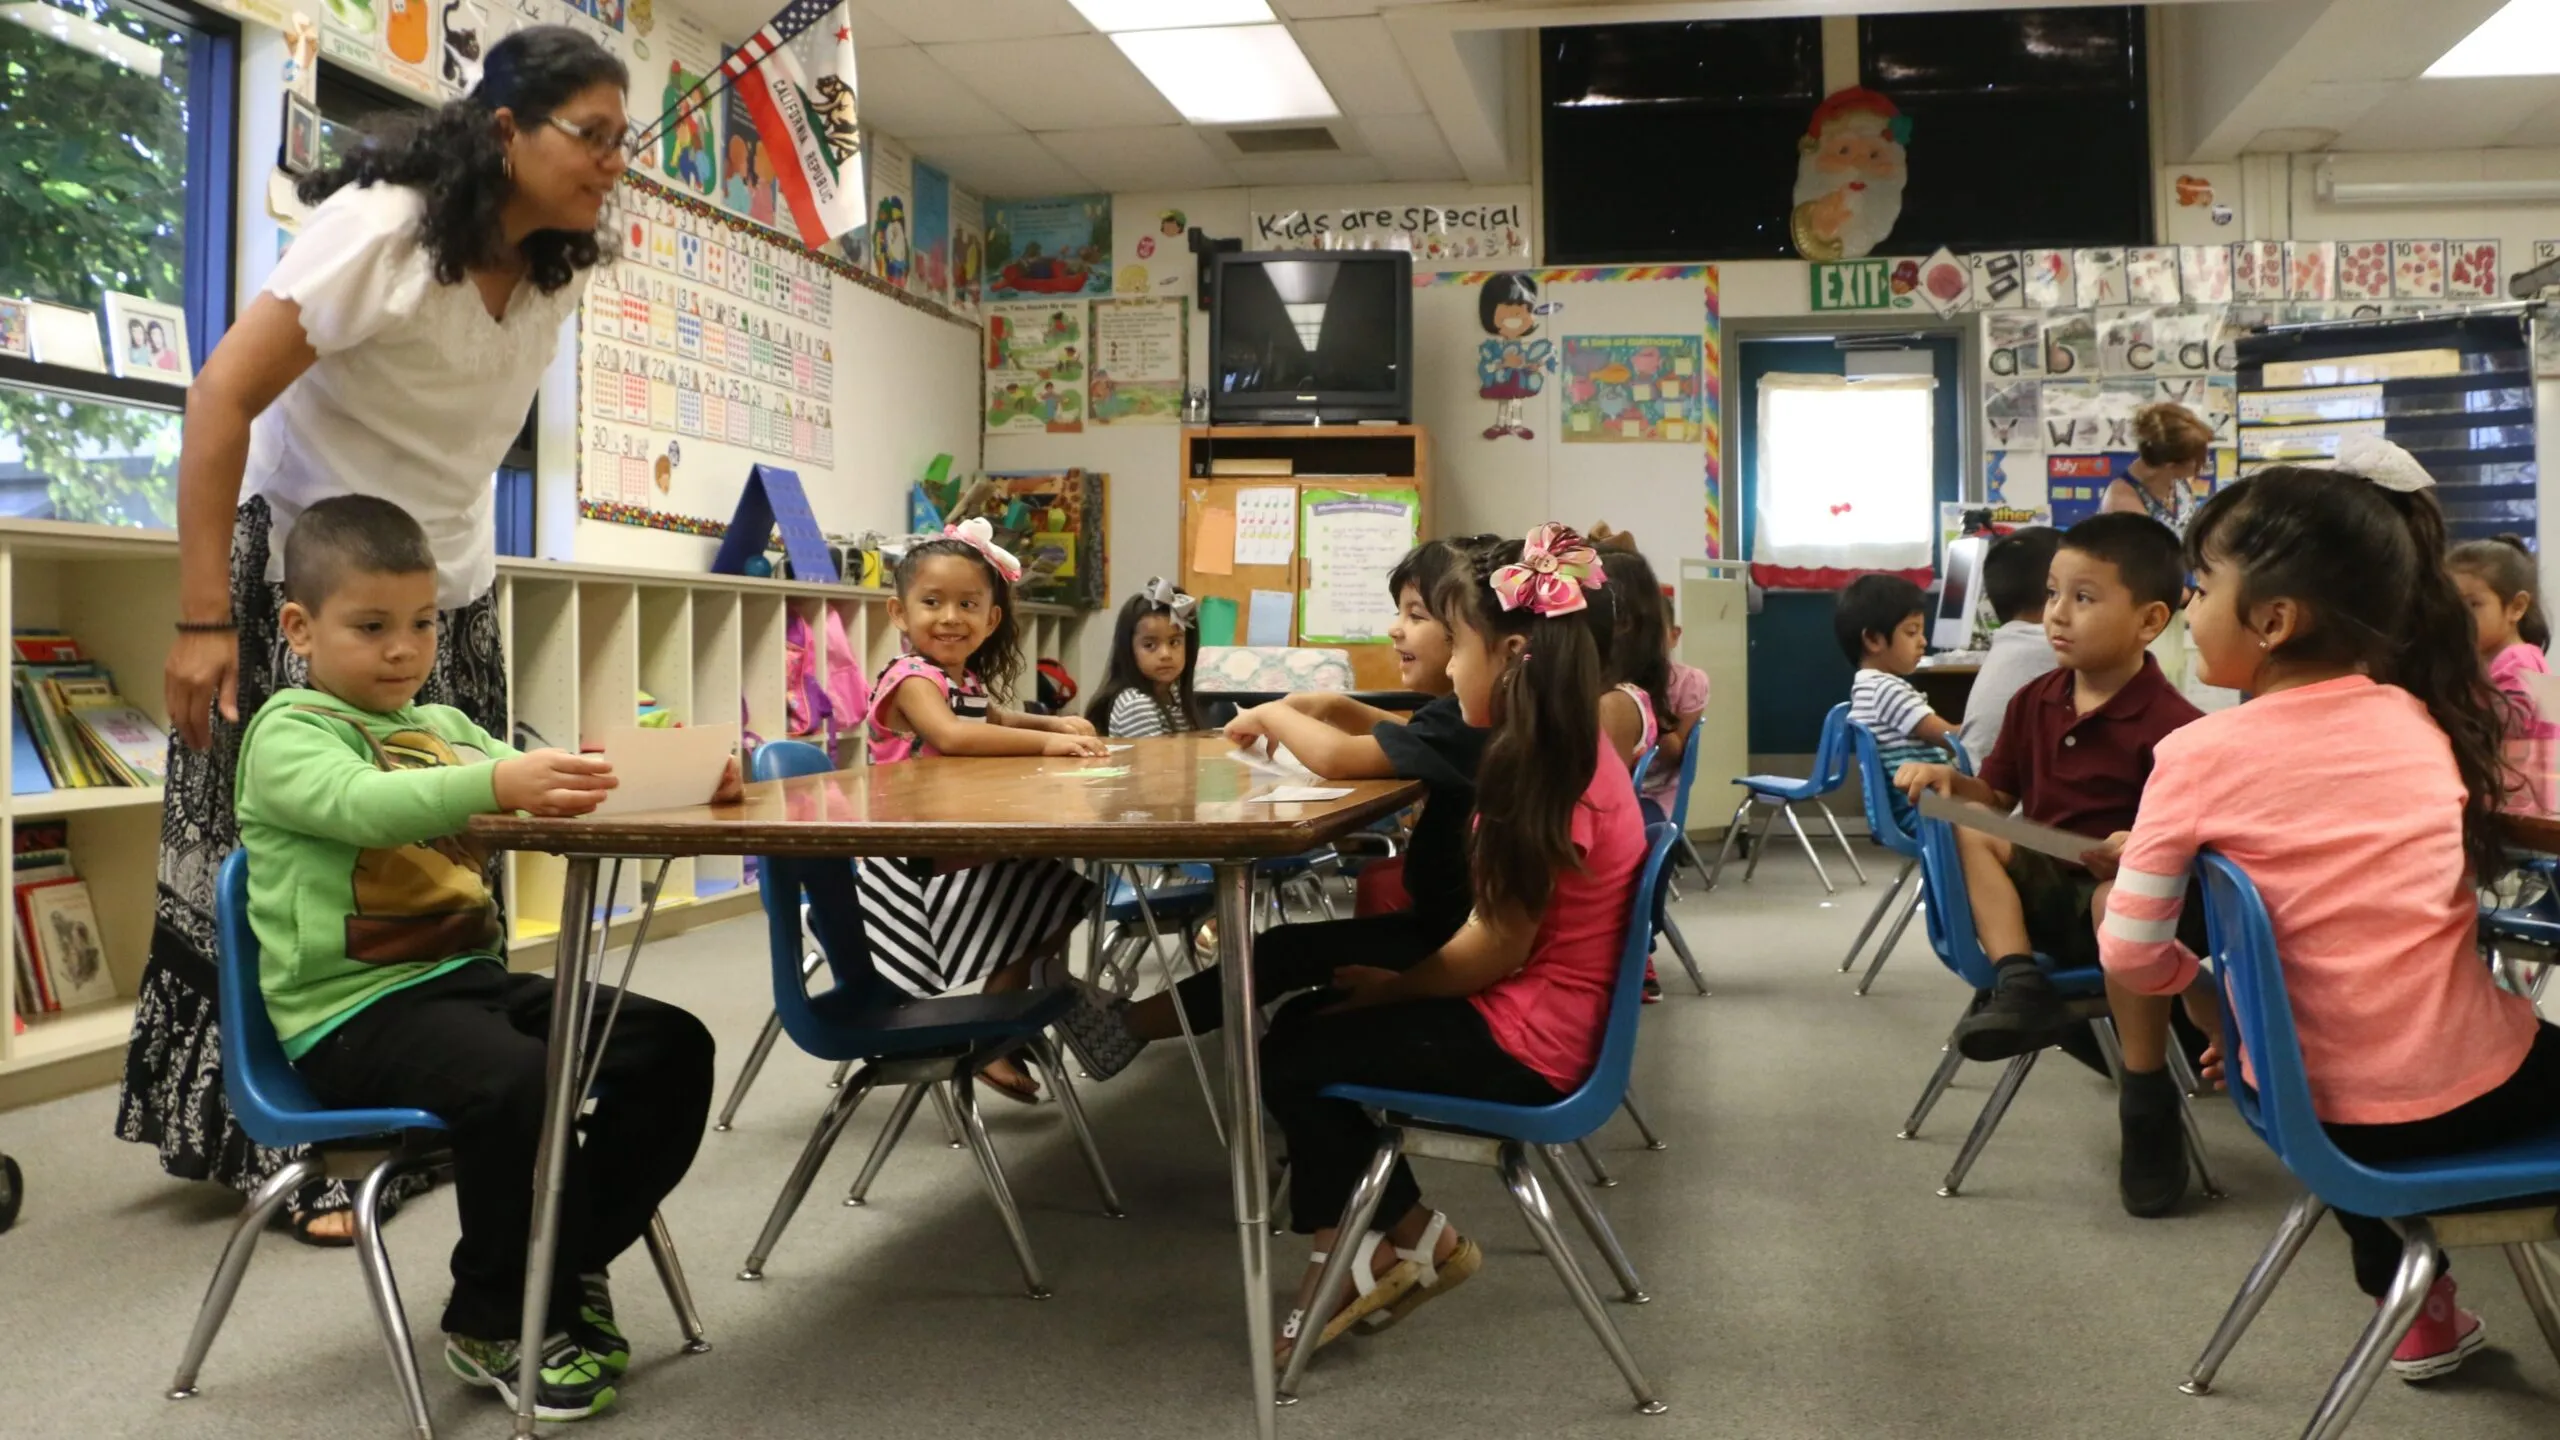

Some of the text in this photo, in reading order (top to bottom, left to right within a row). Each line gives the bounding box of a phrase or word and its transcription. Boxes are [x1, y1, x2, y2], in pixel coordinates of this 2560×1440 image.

[773, 79, 833, 204] CALIFORNIA REPUBLIC
[1258, 211, 1331, 240] Kids
[1341, 209, 1393, 231] are
[2130, 250, 2139, 262] 5
[2236, 245, 2245, 256] 7
[2340, 244, 2349, 257] 9
[2396, 243, 2411, 256] 10
[2450, 243, 2464, 256] 11
[2538, 244, 2554, 257] 12
[1974, 256, 1982, 268] 2
[2025, 254, 2035, 267] 3
[1820, 263, 1882, 307] EXIT
[2044, 328, 2075, 374] b
[2054, 459, 2077, 474] July
